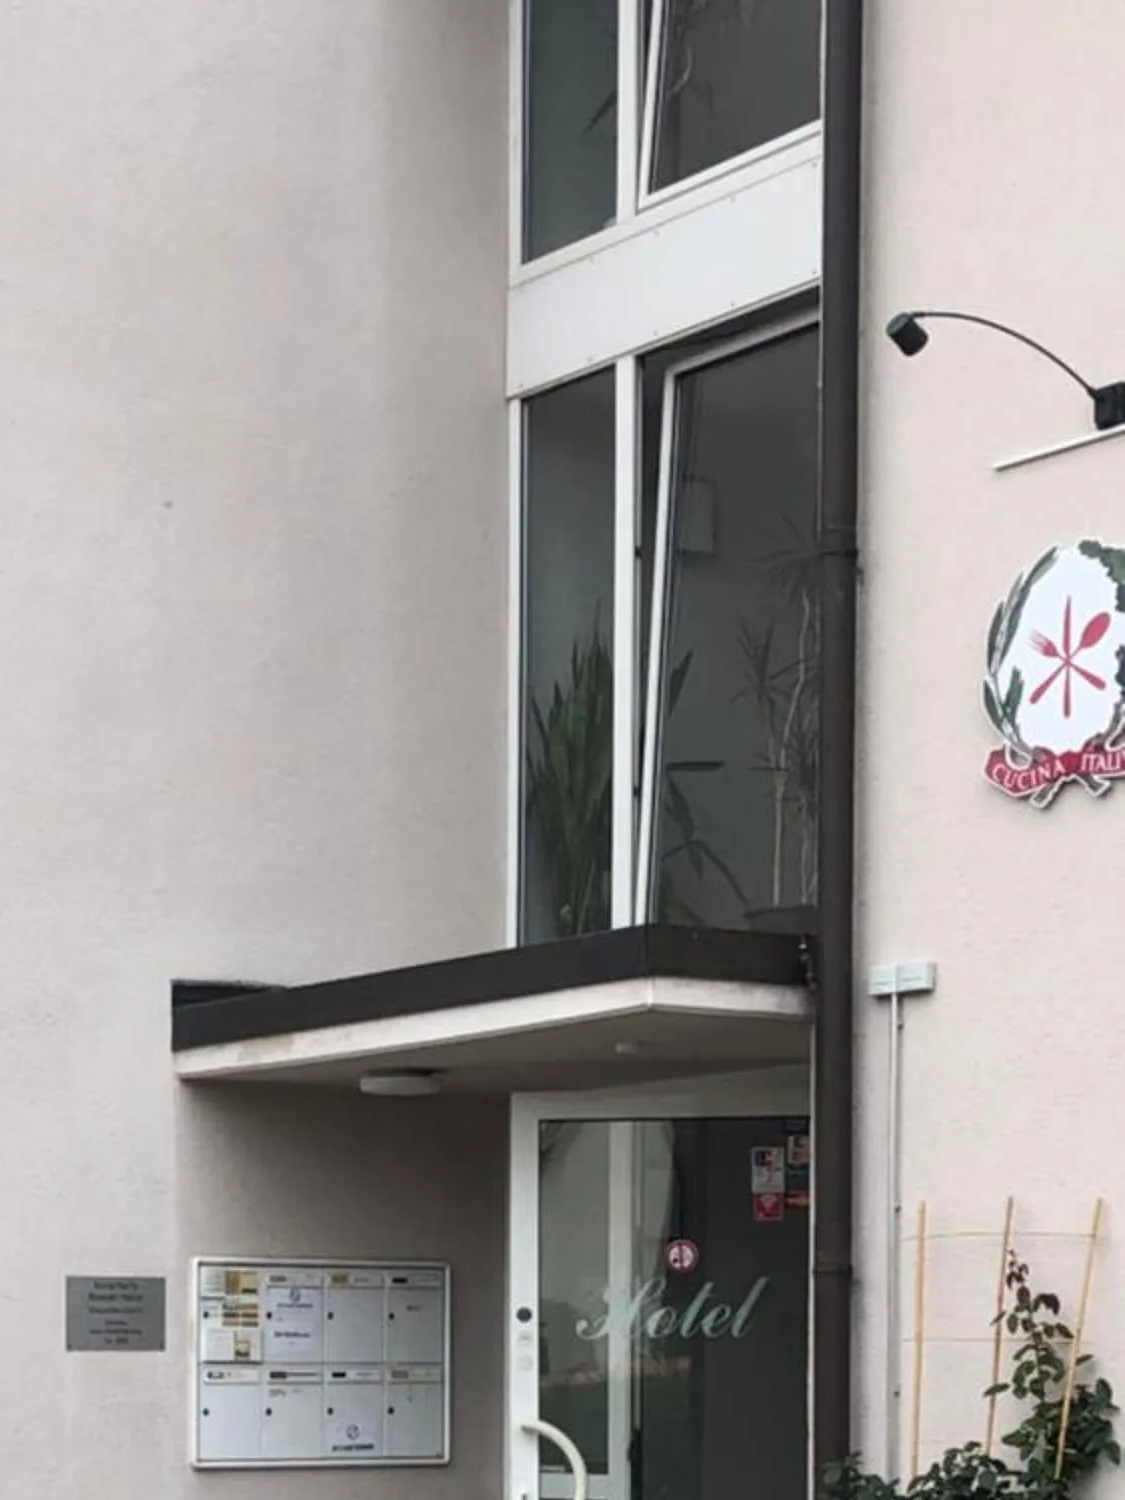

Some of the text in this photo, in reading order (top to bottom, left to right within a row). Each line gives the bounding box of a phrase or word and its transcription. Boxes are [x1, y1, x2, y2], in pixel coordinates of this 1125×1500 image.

[992, 750, 1125, 789] CUCINA ITALI
[575, 1276, 770, 1340] Hotel
